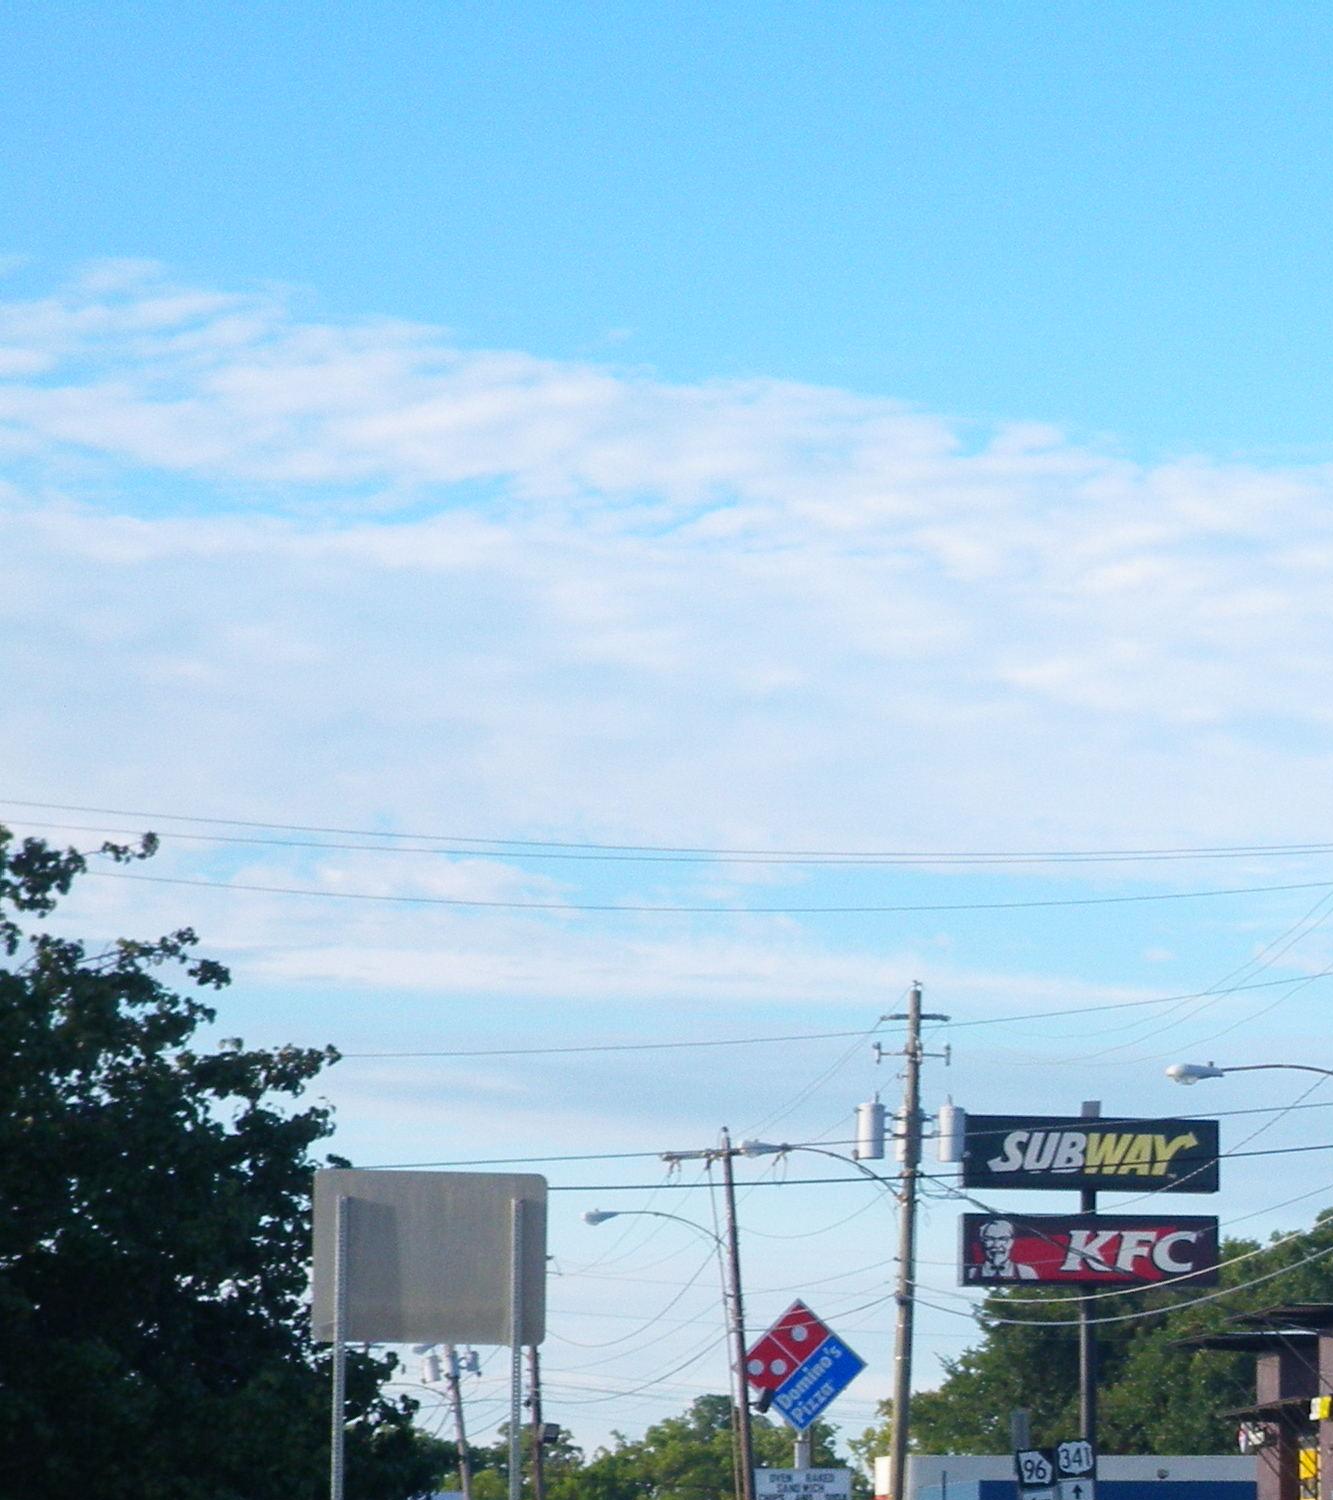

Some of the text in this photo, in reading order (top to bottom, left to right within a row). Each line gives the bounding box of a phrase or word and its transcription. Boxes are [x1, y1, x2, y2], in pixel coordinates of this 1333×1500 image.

[987, 1131, 1198, 1176] SUBWAY
[1060, 1230, 1196, 1273] KFC
[775, 1346, 842, 1410] Domino's
[791, 1381, 836, 1424] Pizza
[1024, 1459, 1047, 1480] 96
[1060, 1447, 1091, 1469] 341
